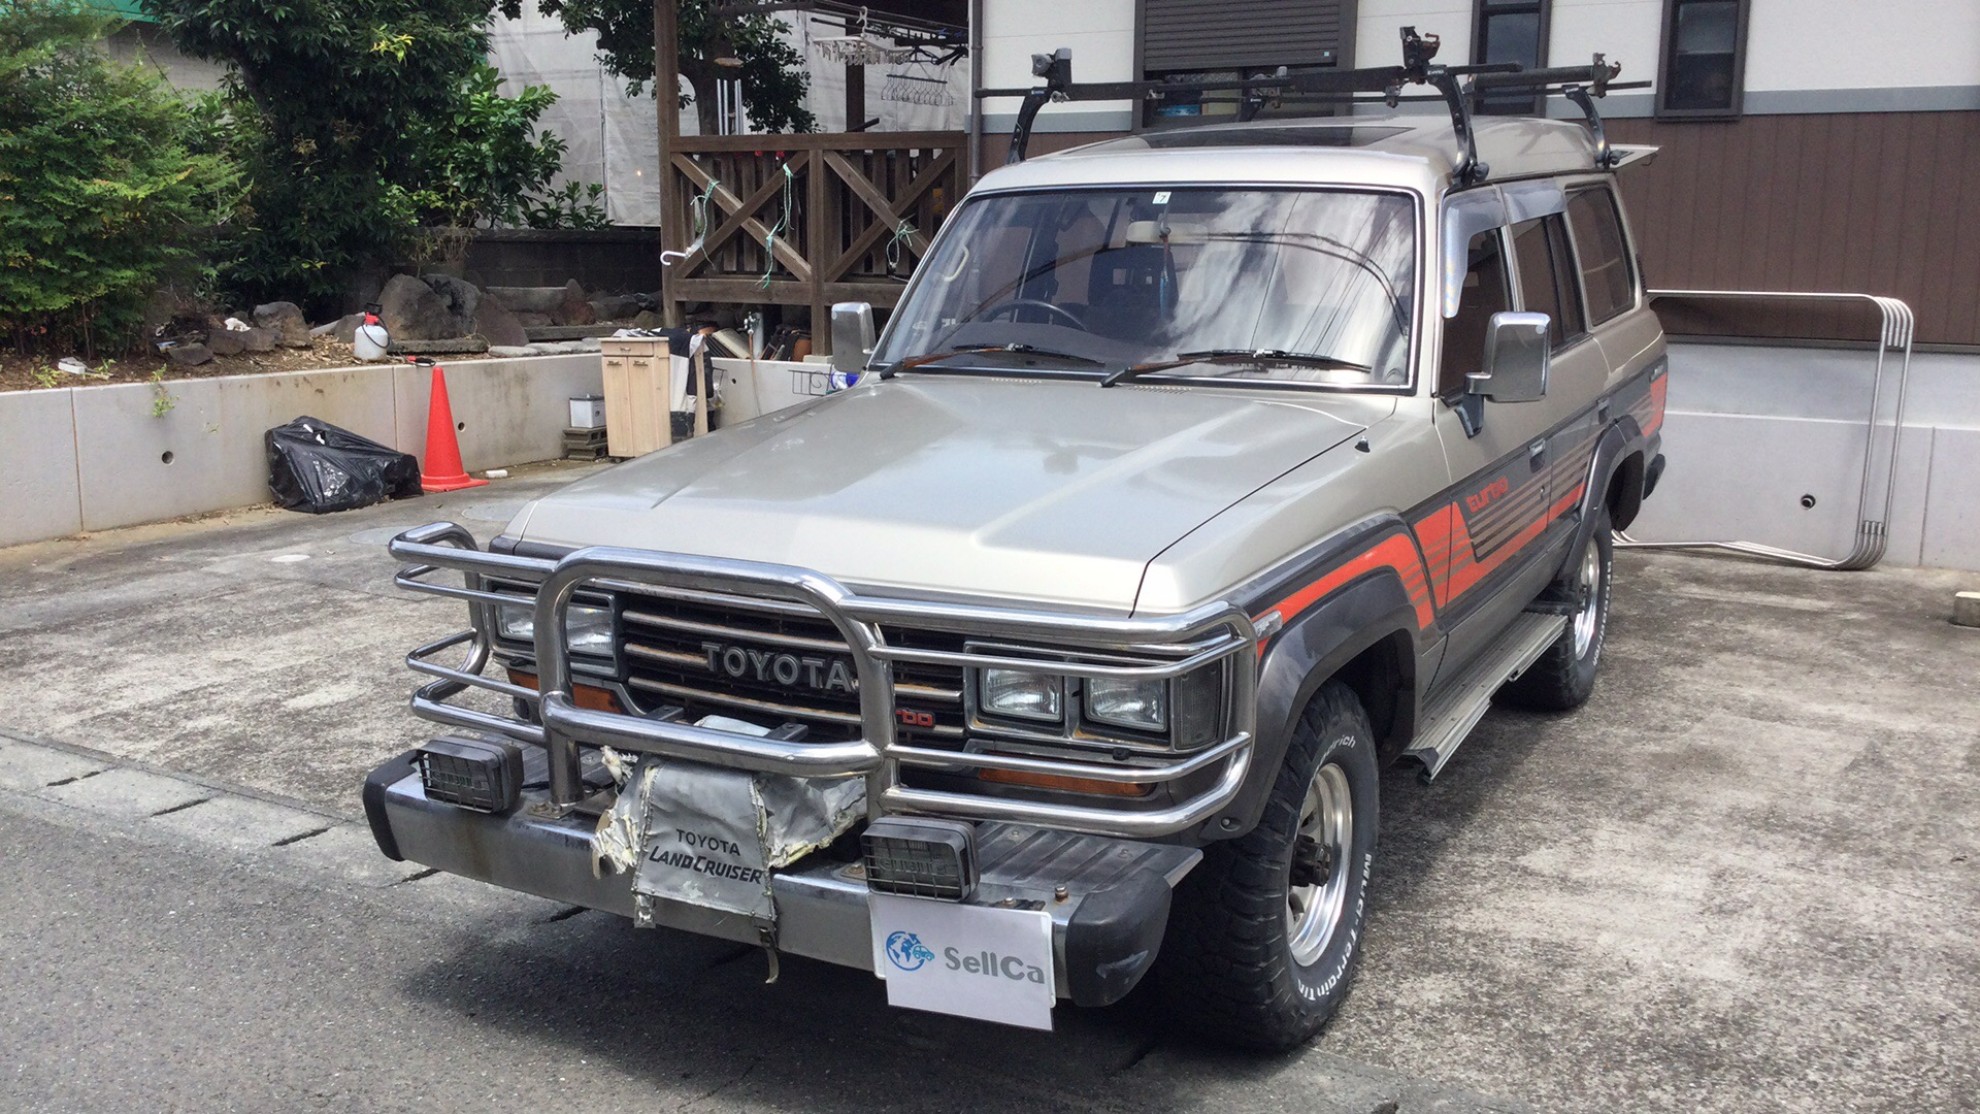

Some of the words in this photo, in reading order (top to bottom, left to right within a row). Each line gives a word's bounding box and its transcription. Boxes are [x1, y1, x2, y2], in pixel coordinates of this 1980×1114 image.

[702, 641, 850, 691] TOYOTA
[676, 828, 741, 857] TOYOTA
[944, 946, 1045, 985] SellCa
